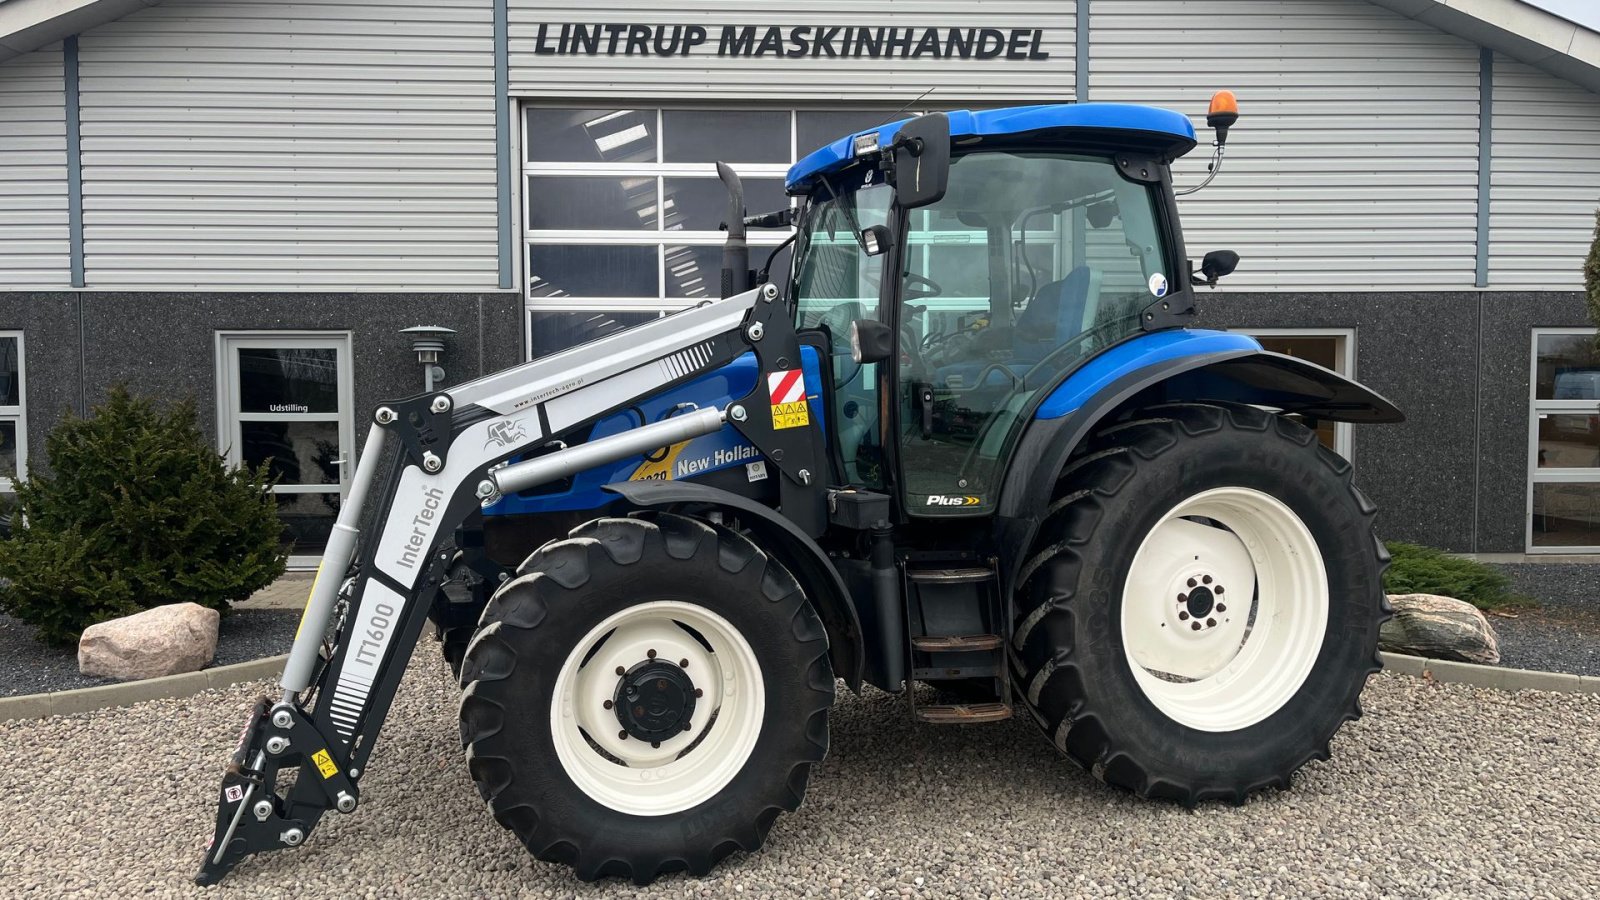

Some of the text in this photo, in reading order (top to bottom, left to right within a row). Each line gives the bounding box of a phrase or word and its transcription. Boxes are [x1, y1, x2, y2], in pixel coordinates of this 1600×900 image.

[535, 23, 1050, 60] LINTRUP MASKINHANDEL
[269, 404, 308, 413] Udstilling
[677, 445, 759, 476] New Hollan
[926, 495, 964, 506] Plus
[396, 487, 444, 569] InterTech
[355, 603, 394, 667] IT1600
